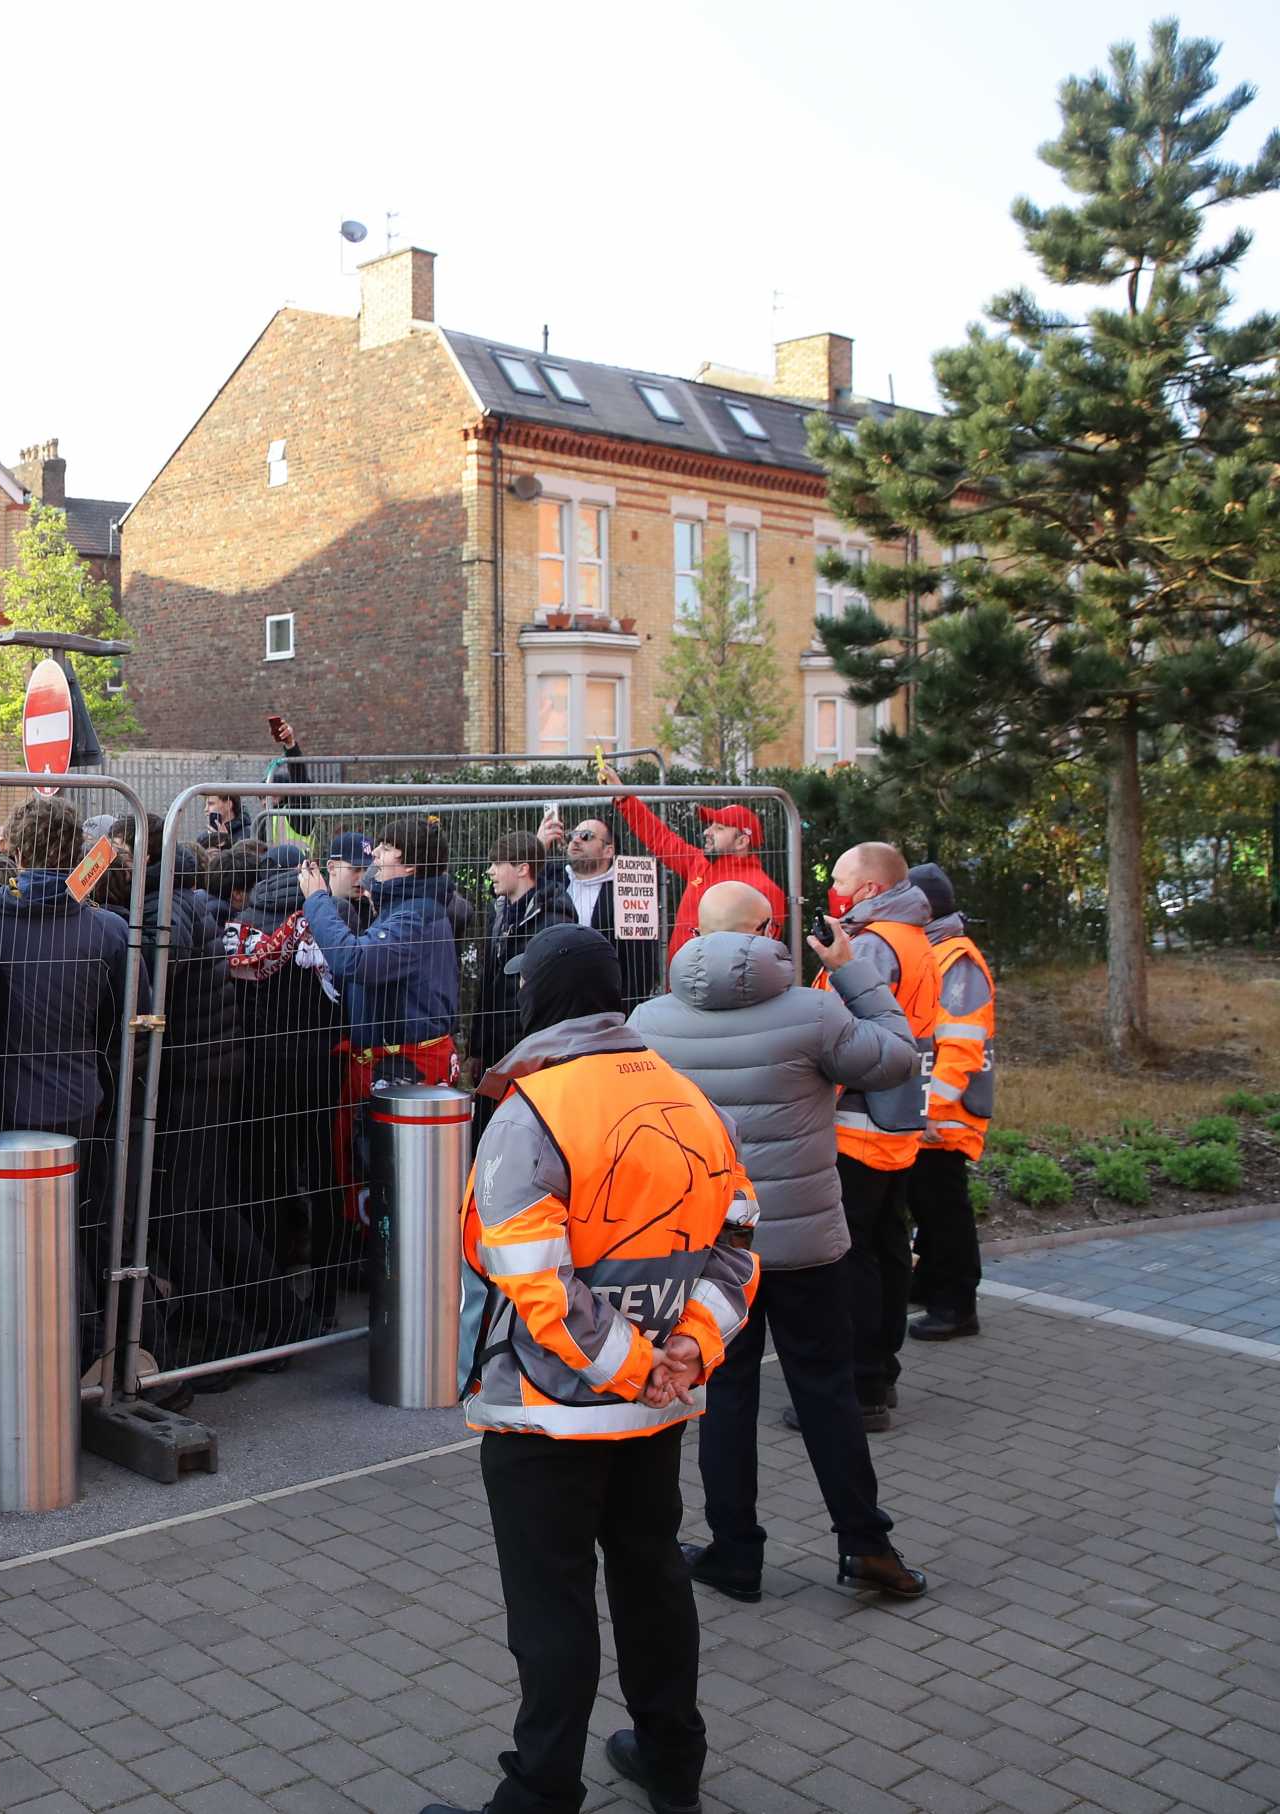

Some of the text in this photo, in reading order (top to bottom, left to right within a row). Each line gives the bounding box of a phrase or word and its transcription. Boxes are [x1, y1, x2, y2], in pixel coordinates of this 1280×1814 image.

[617, 860, 652, 870] BLACKPOOL
[617, 873, 654, 883] DEMOLITION
[618, 886, 654, 896] EMPLOYEES
[623, 900, 649, 909] ONLY
[624, 913, 649, 923] BEYOND
[620, 926, 654, 936] THIS POINT
[615, 1060, 657, 1074] 2018/21
